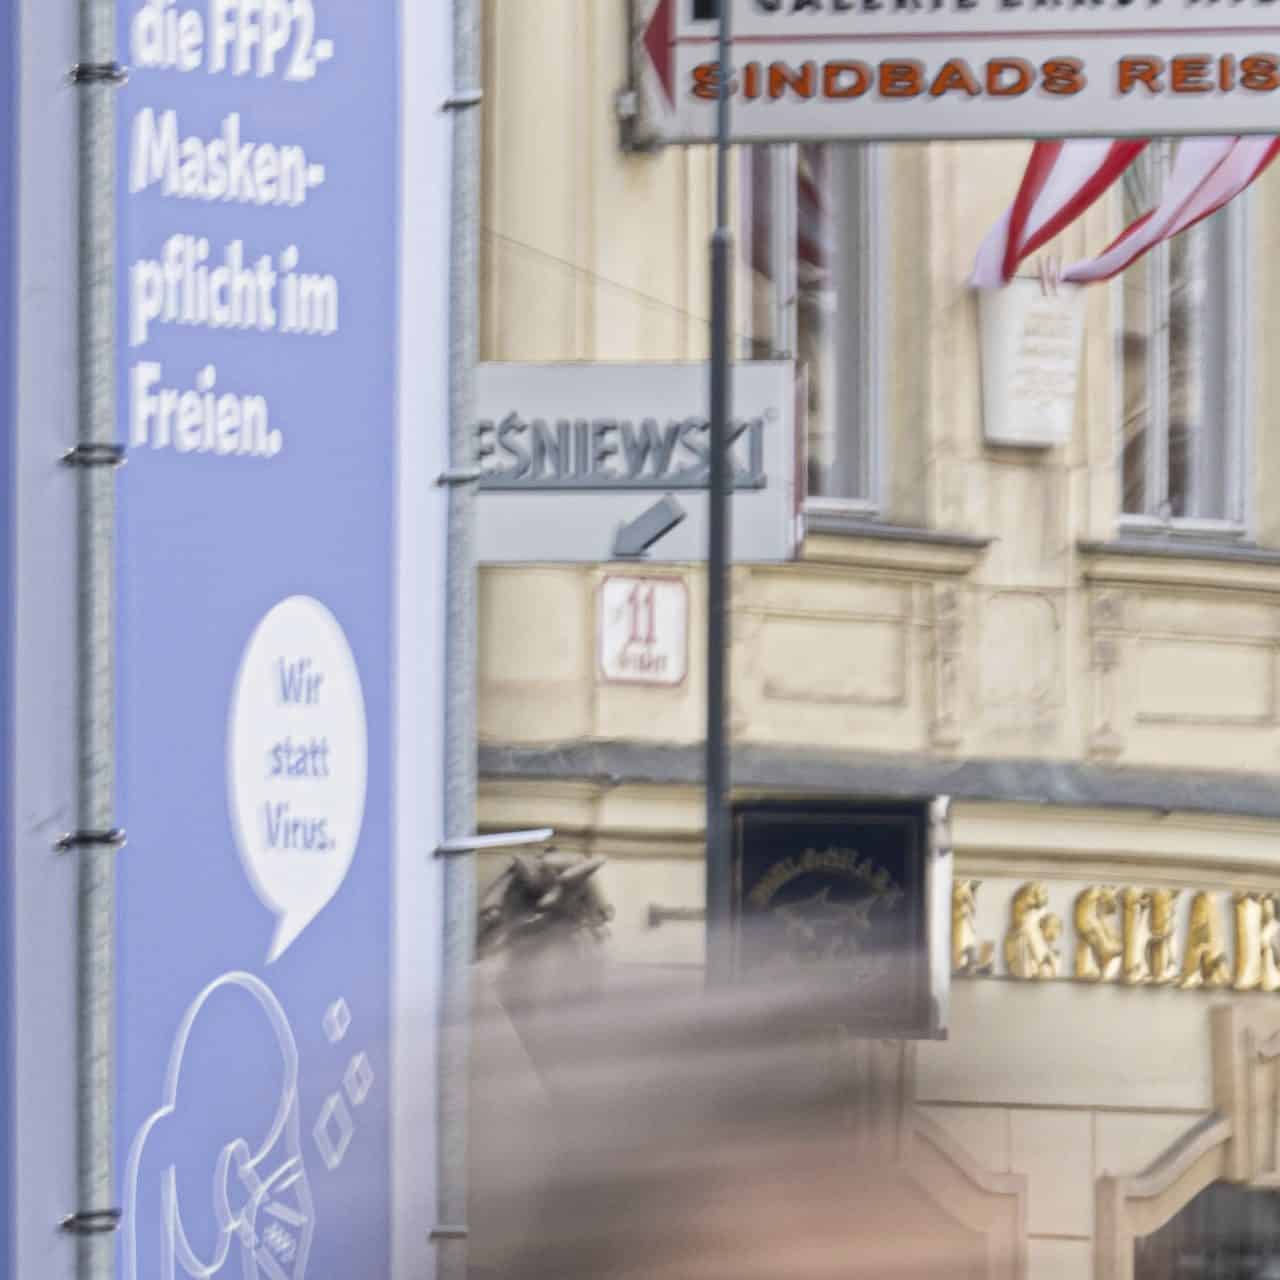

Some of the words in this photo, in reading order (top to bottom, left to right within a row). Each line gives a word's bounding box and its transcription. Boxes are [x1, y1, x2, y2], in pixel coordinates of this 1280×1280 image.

[131, 0, 203, 71] die
[208, 0, 335, 81] FFP2-
[690, 56, 1086, 100] SINDBADS
[129, 106, 325, 208] Masken-
[129, 233, 276, 347] pflicht
[278, 244, 338, 336] im
[129, 360, 283, 458] Freien.
[627, 583, 657, 644] 11
[276, 656, 323, 704] Wir
[269, 736, 330, 776] statt
[264, 800, 336, 850] Virus.
